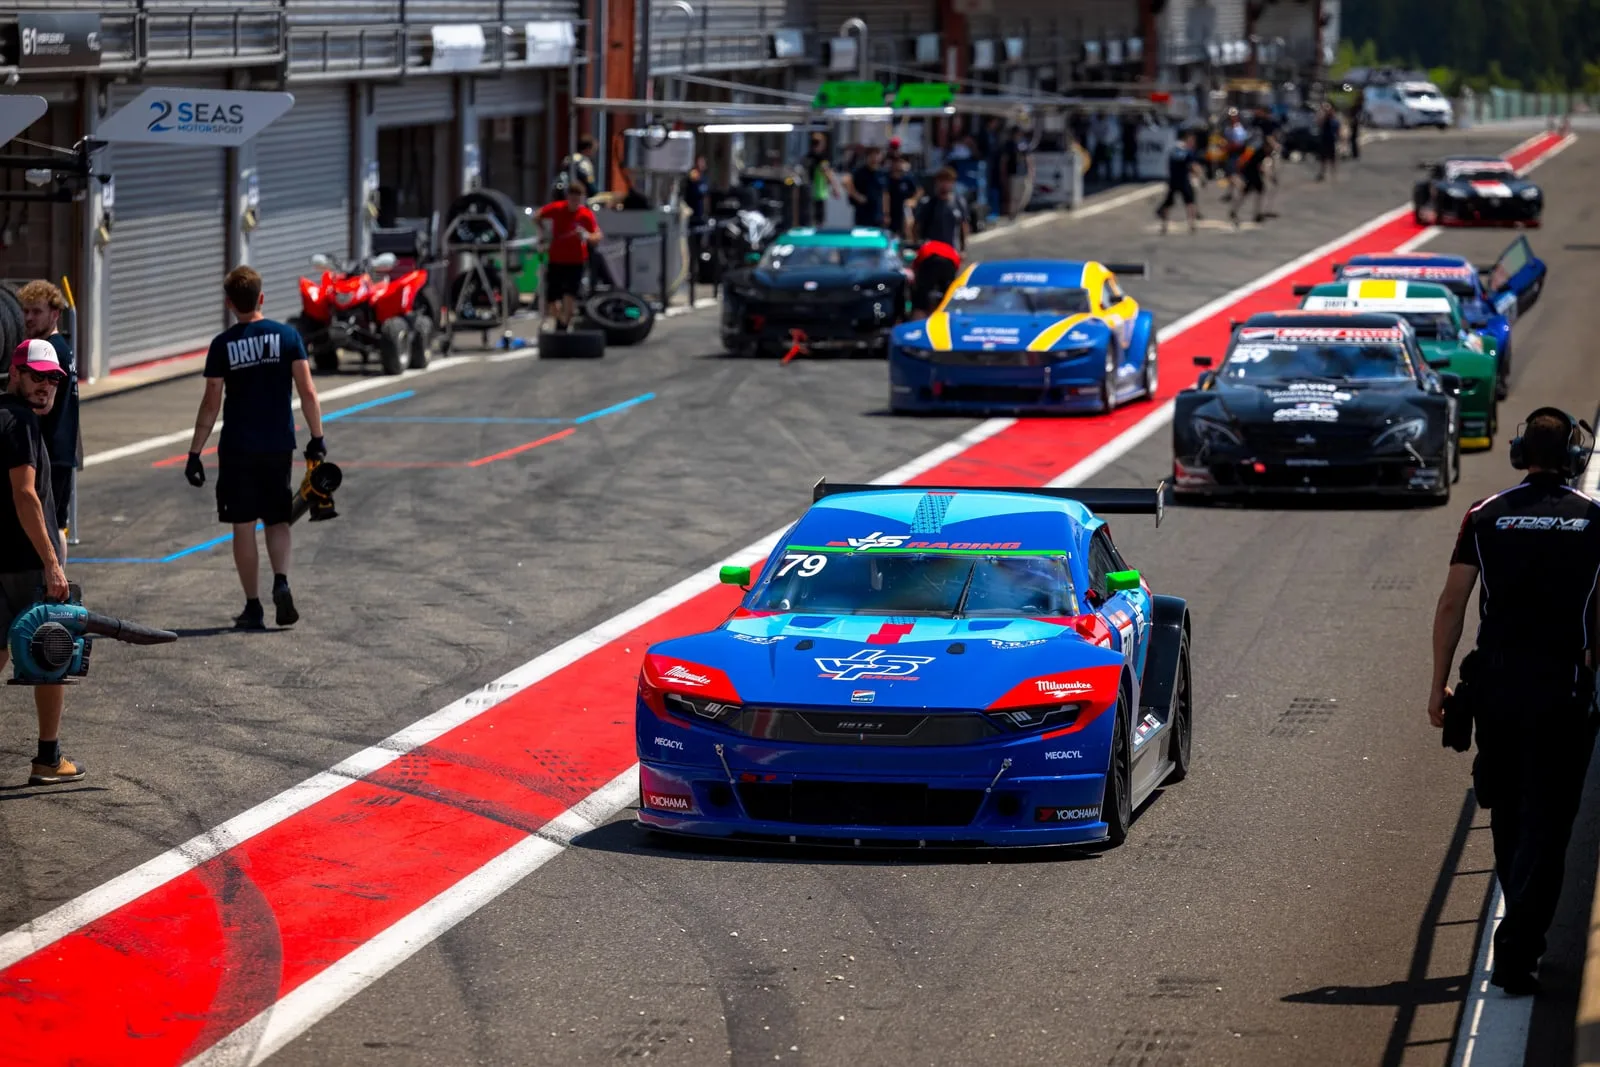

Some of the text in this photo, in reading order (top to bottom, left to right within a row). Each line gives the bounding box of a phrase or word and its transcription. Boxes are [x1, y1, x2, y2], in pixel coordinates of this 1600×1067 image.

[22, 27, 37, 55] 61
[178, 102, 244, 124] SEAS
[177, 124, 243, 134] MOTORSPORT
[227, 333, 280, 366] DRIV'N
[905, 541, 1022, 550] RACING
[777, 554, 828, 577] 79
[1035, 680, 1092, 691] Milwaukee
[654, 736, 684, 750] MECACYL
[1045, 750, 1083, 760] MECACYL
[1056, 807, 1099, 820] YOKOHAMA
